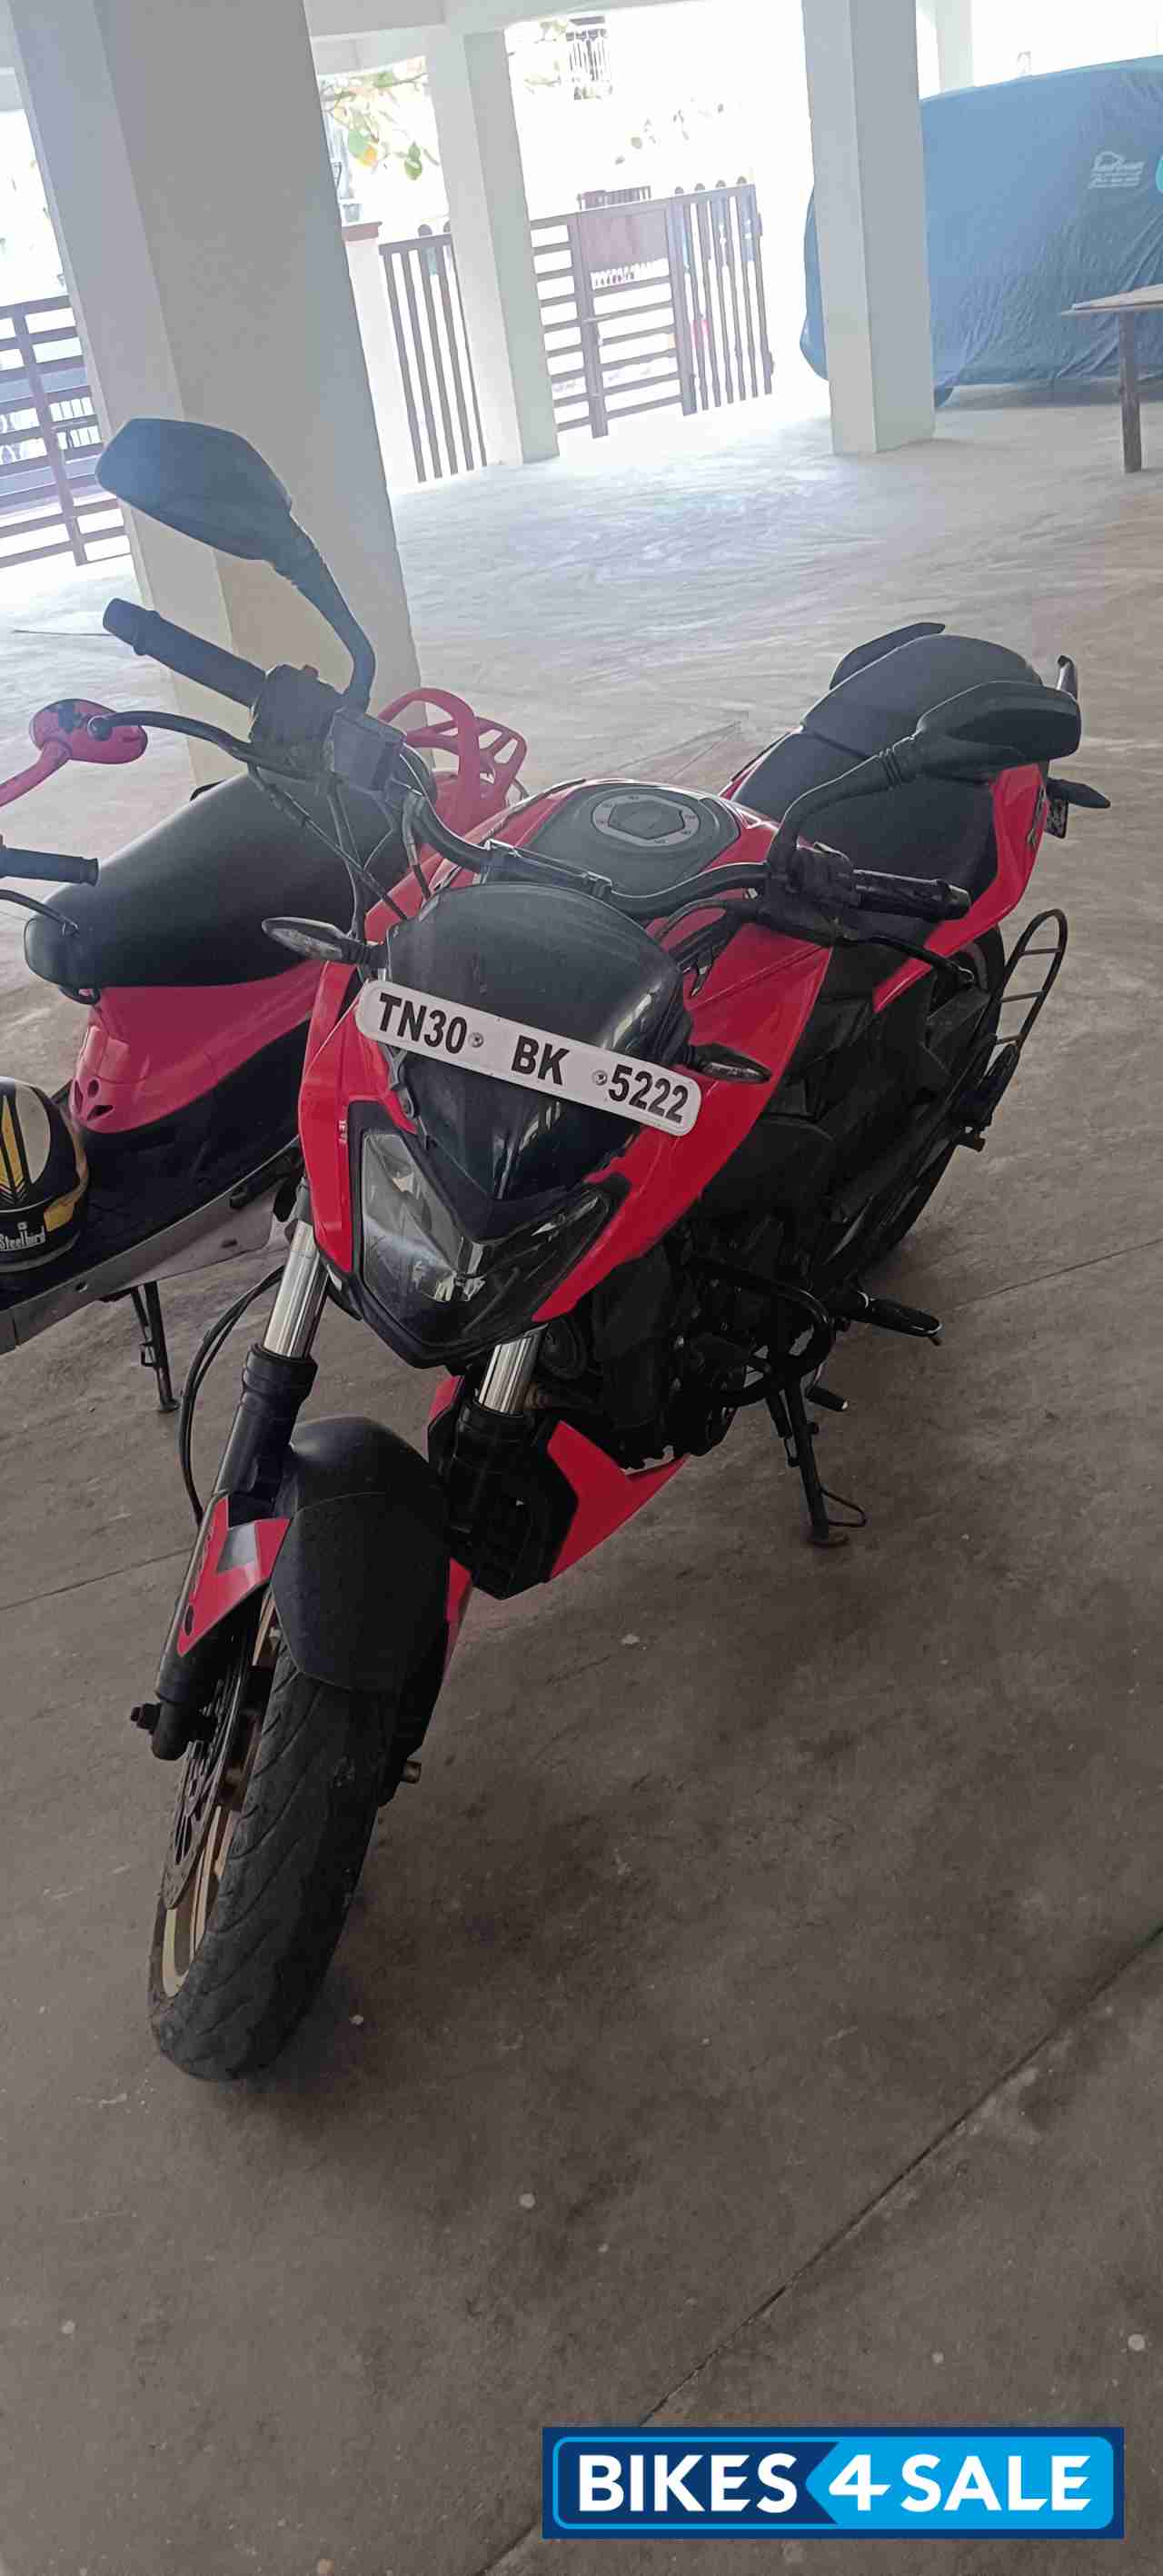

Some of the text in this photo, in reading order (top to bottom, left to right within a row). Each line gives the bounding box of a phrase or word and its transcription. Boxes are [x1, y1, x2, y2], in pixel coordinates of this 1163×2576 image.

[379, 992, 689, 1124] TN30 BK 5222
